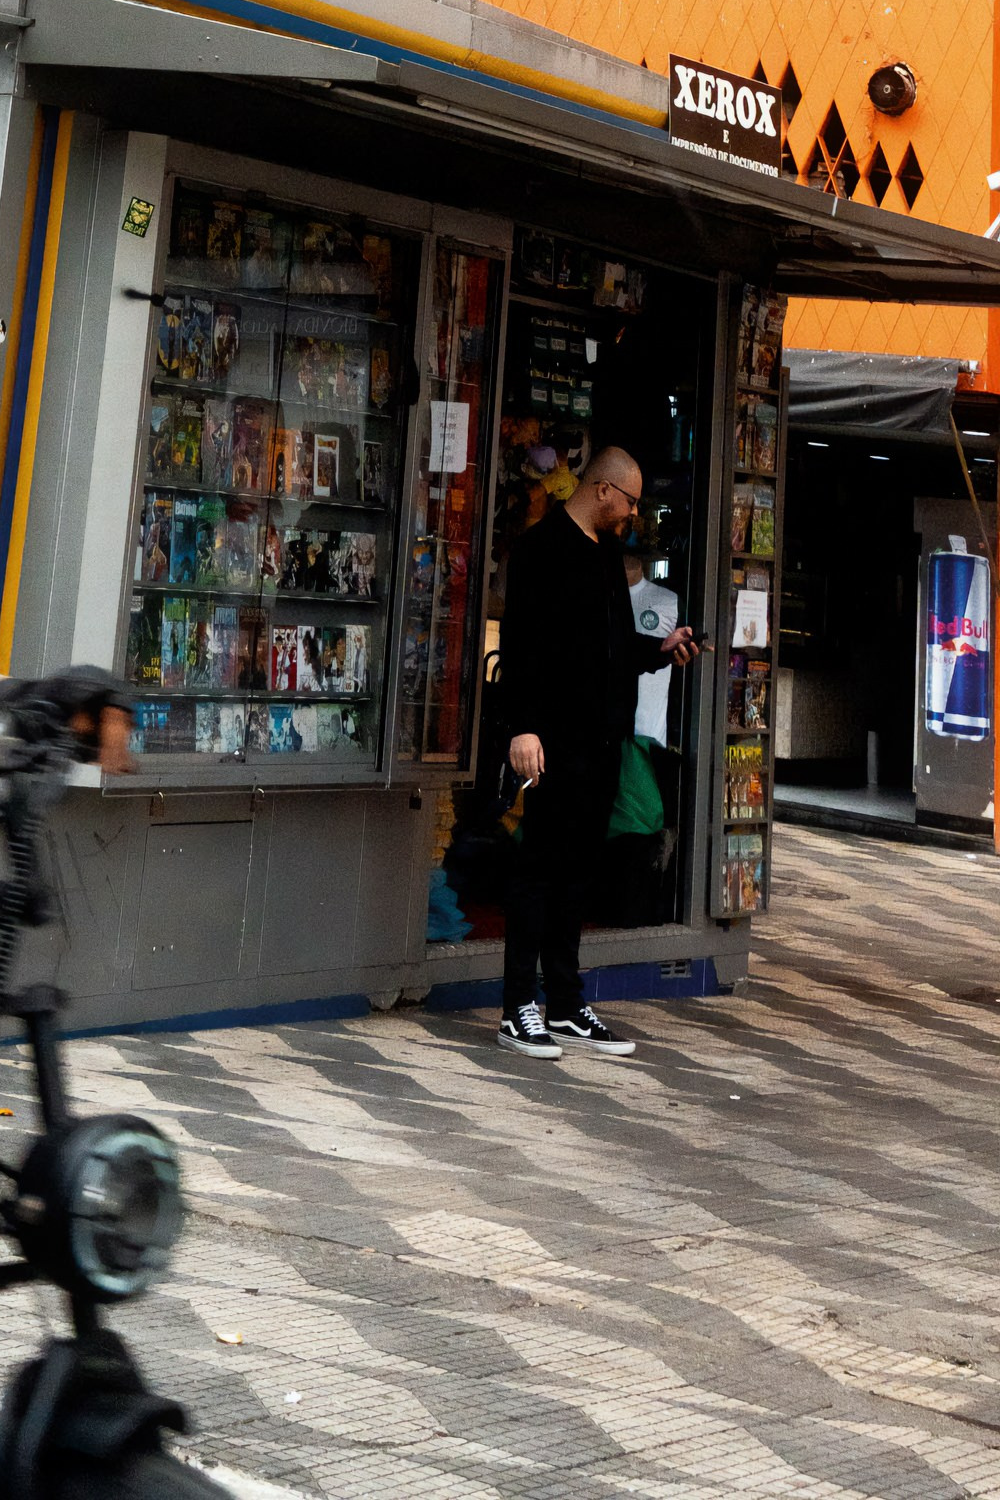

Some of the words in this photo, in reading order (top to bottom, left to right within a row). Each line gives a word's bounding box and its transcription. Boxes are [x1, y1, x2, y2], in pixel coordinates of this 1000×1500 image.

[673, 64, 777, 137] XEROX
[722, 129, 730, 144] E
[671, 136, 718, 160] IMPRESSÕES
[718, 150, 730, 164] DE
[729, 153, 779, 178] DOCUMENTOS
[961, 617, 989, 639] Bull
